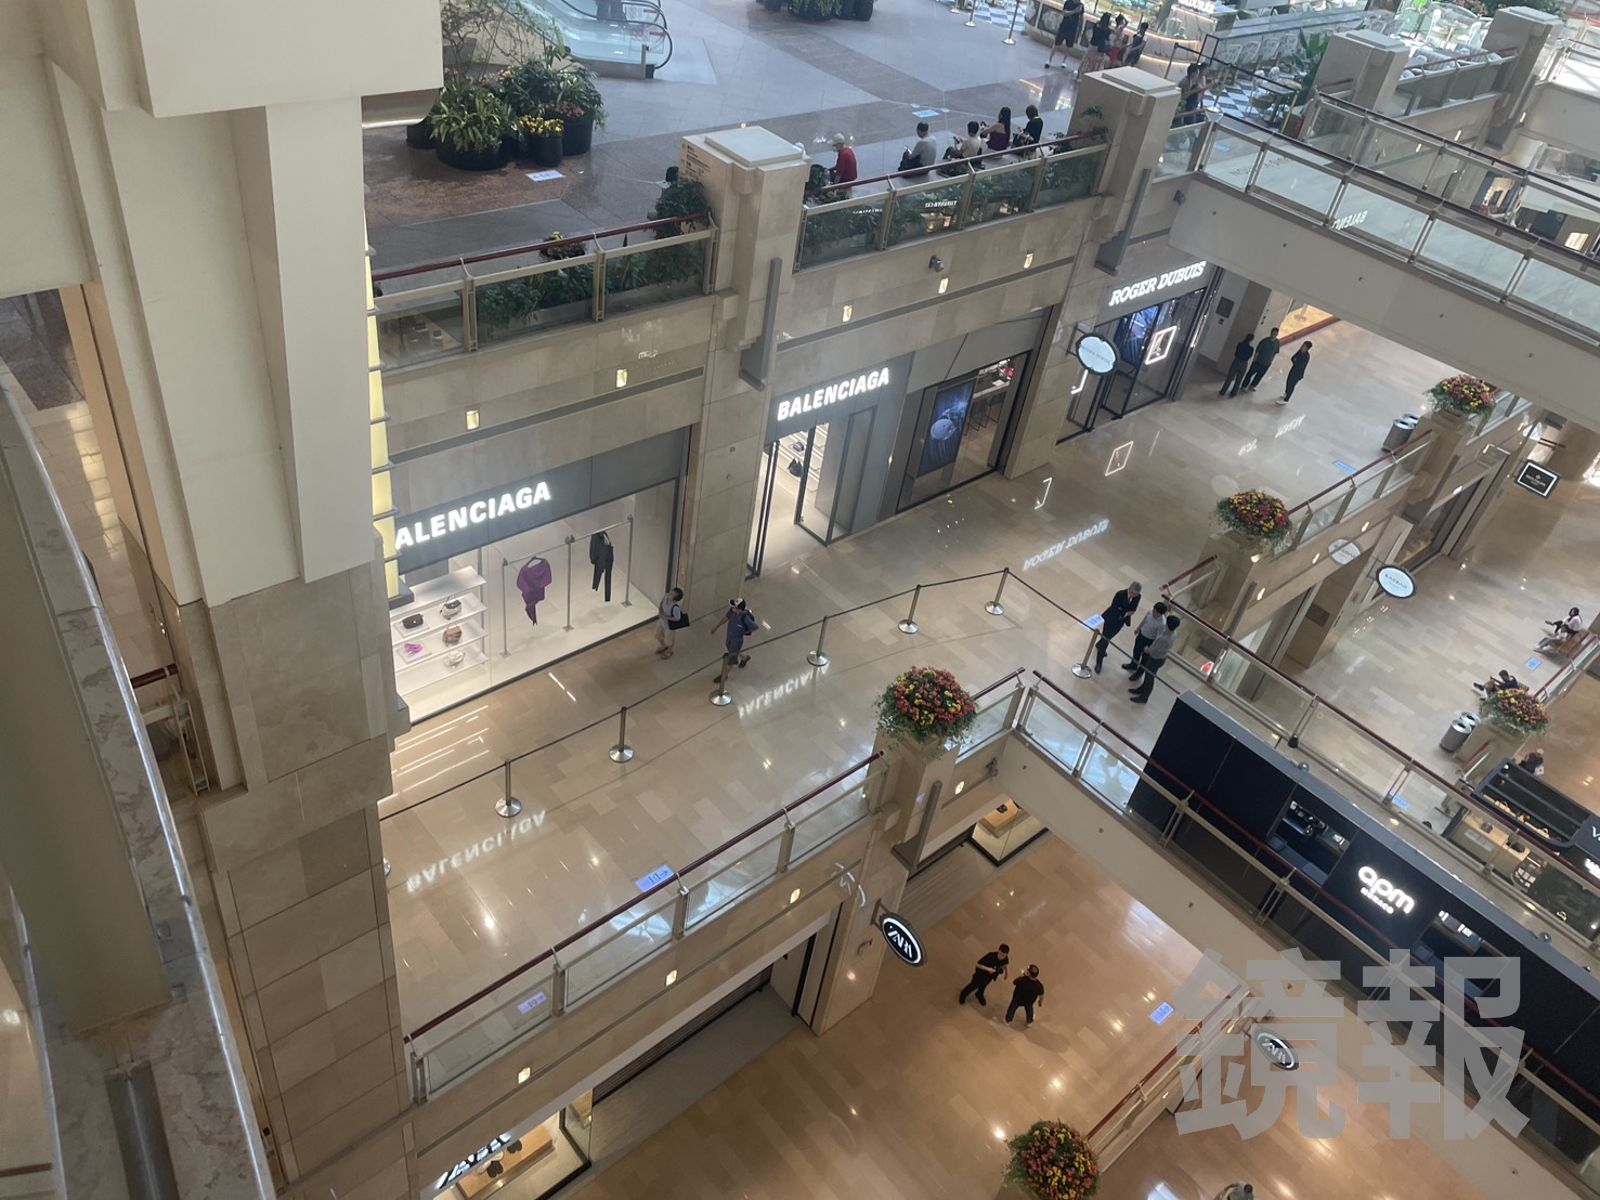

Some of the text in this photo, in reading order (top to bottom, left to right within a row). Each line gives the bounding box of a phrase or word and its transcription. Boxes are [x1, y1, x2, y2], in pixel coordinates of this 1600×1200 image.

[1109, 260, 1207, 306] ROGER DUBUIS
[777, 367, 889, 421] BALENCIAGA
[395, 481, 551, 550] ALENCIAGA
[1358, 866, 1415, 914] apm
